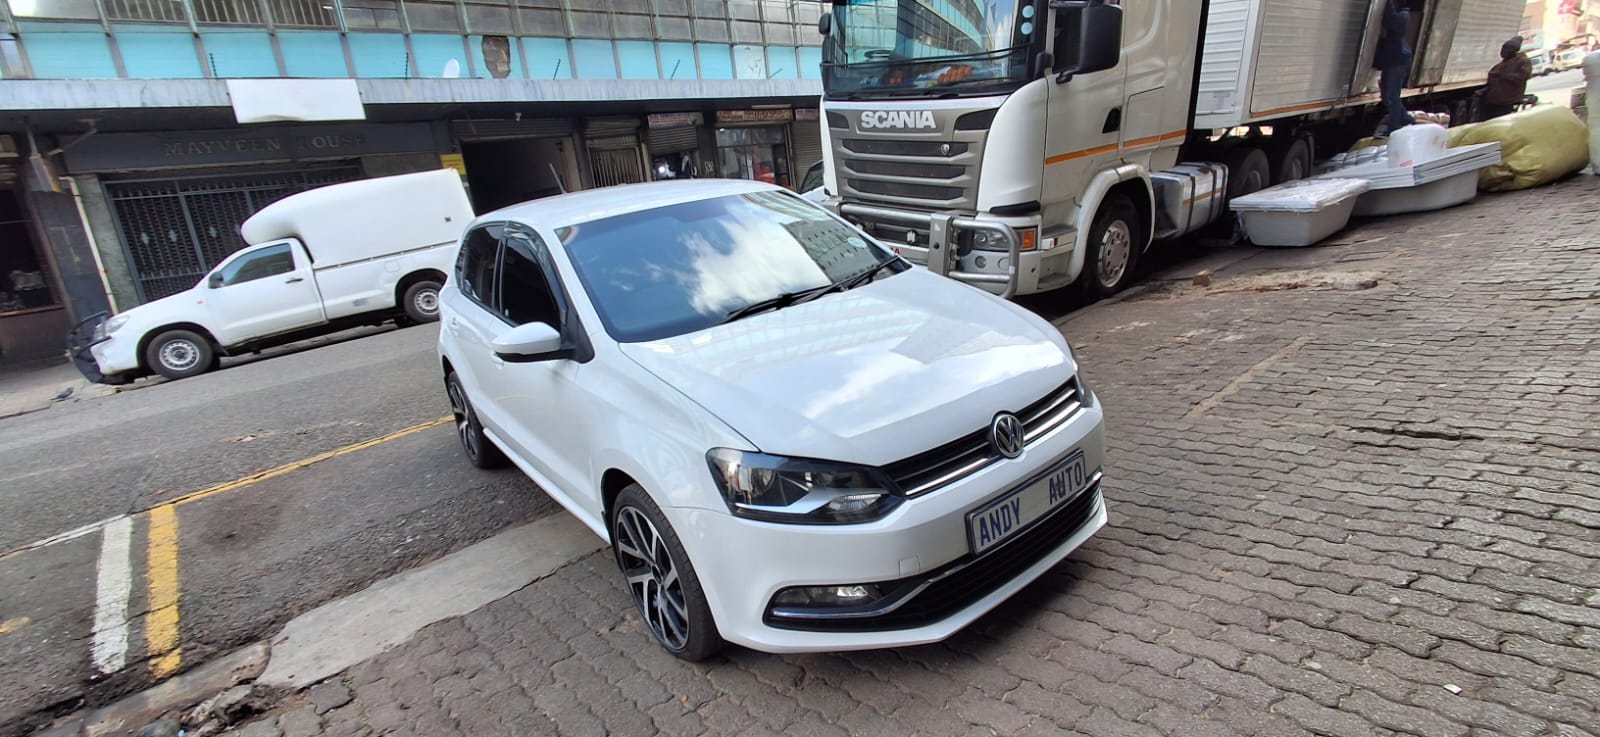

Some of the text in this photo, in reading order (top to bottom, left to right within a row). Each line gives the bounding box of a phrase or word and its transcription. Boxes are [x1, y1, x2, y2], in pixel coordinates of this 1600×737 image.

[861, 110, 937, 129] SCANIA
[979, 461, 1082, 547] ANDY AUTO
